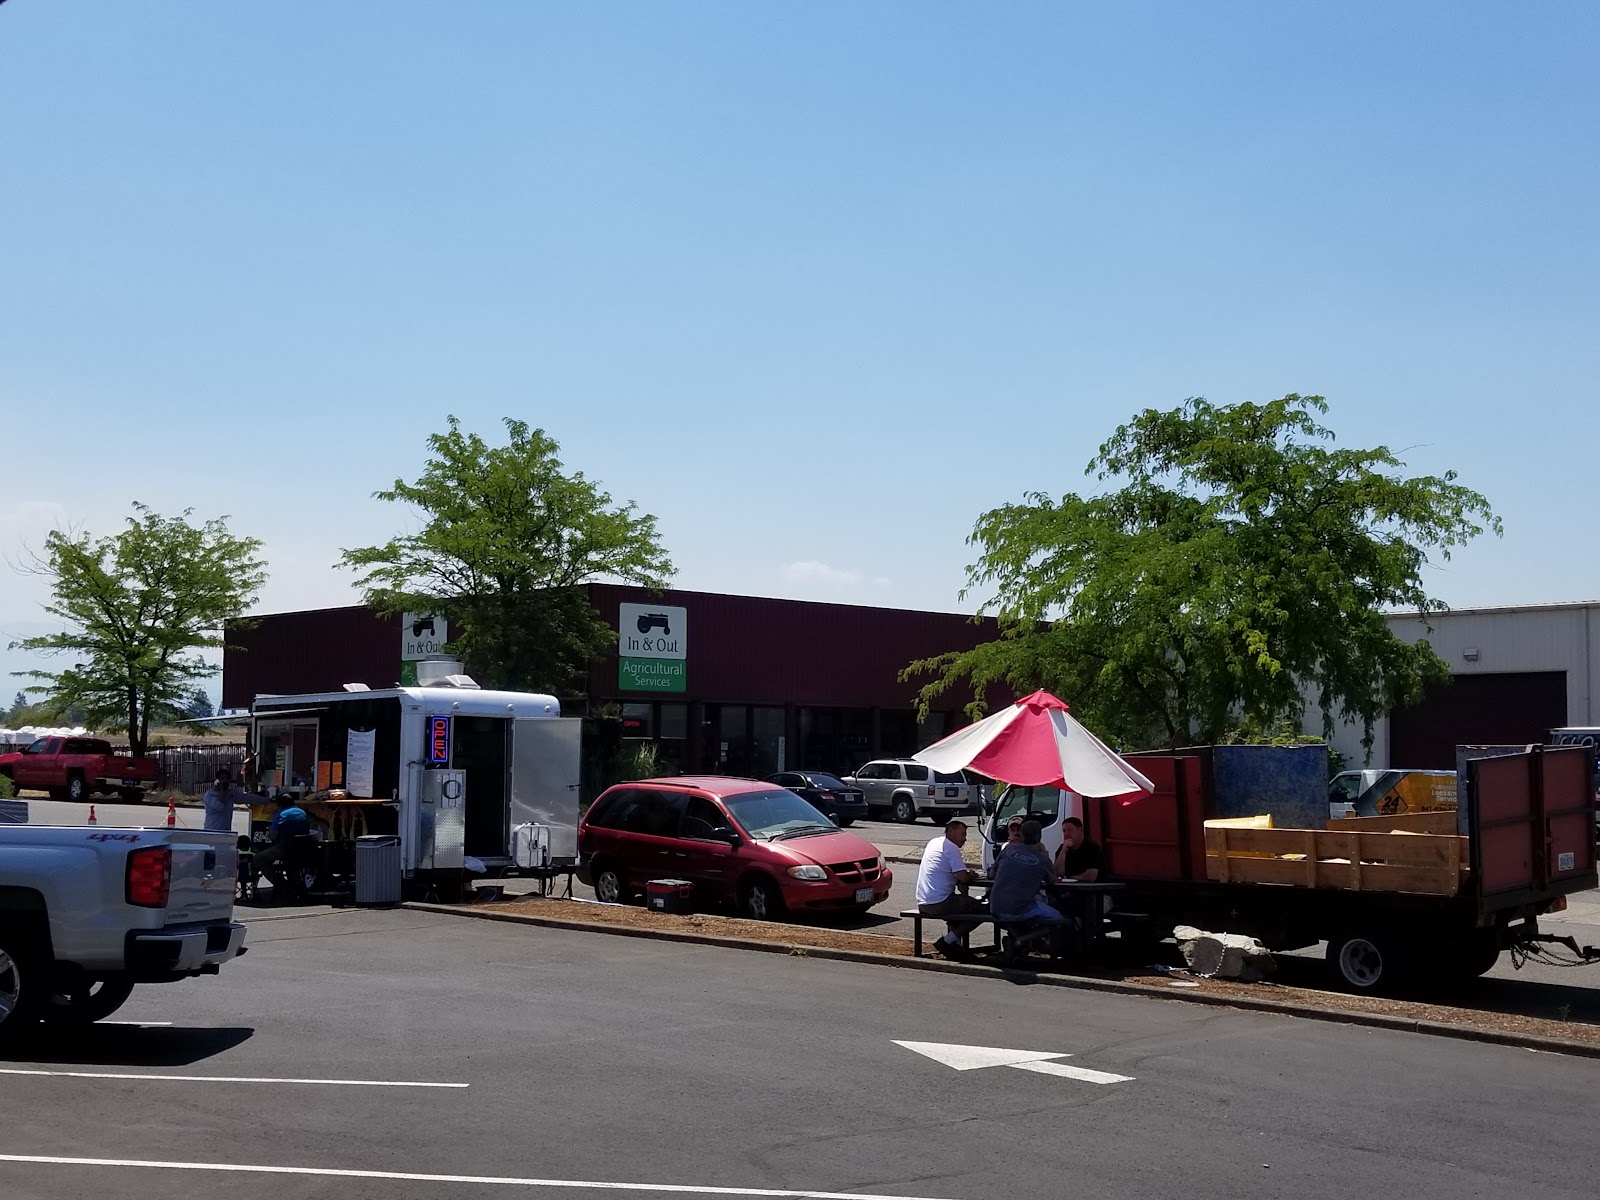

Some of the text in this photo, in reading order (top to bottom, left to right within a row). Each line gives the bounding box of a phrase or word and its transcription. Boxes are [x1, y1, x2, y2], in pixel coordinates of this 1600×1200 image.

[407, 641, 415, 655] In
[416, 640, 425, 654] &
[628, 636, 679, 653] In & Out
[622, 661, 683, 677] Agricultural
[635, 675, 671, 687] Services
[434, 720, 446, 759] OPEN
[1382, 795, 1400, 808] 24
